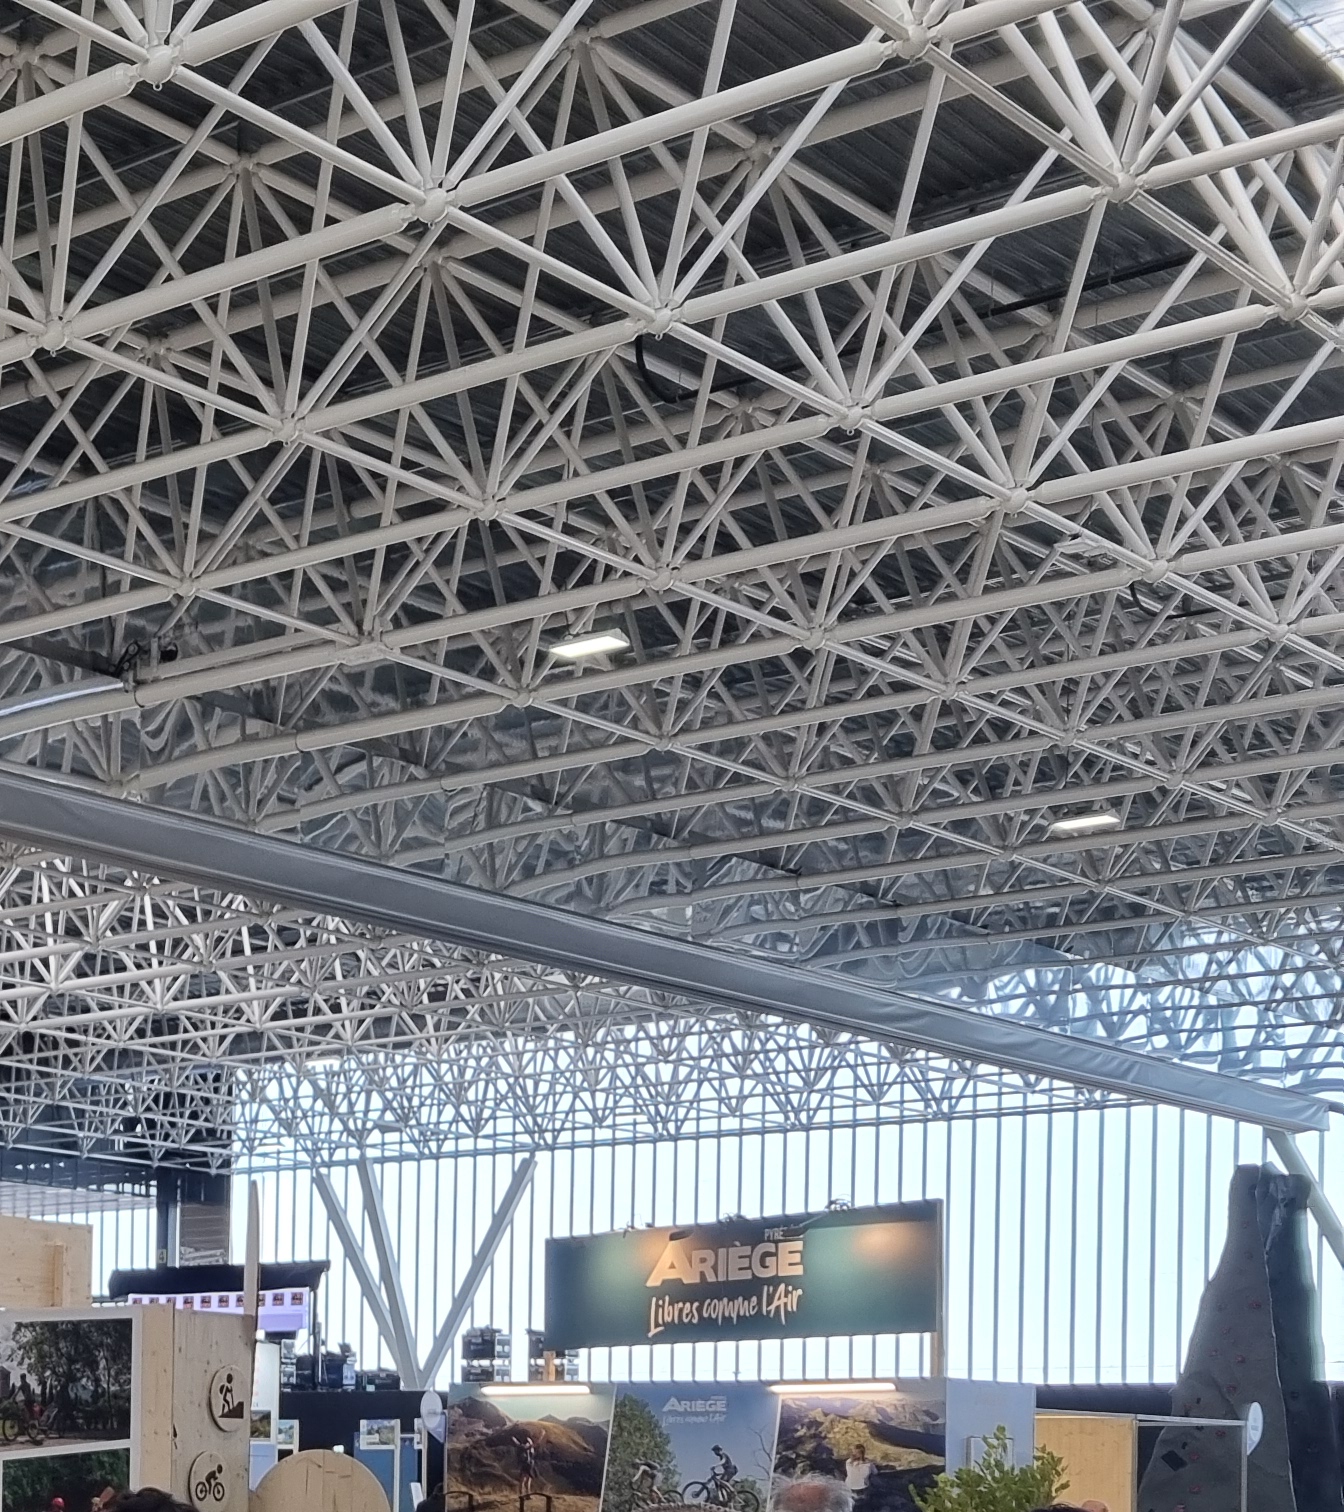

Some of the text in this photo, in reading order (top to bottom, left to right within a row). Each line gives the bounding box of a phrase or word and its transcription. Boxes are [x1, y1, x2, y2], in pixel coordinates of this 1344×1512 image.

[647, 1283, 804, 1338] Libres comme l'Air
